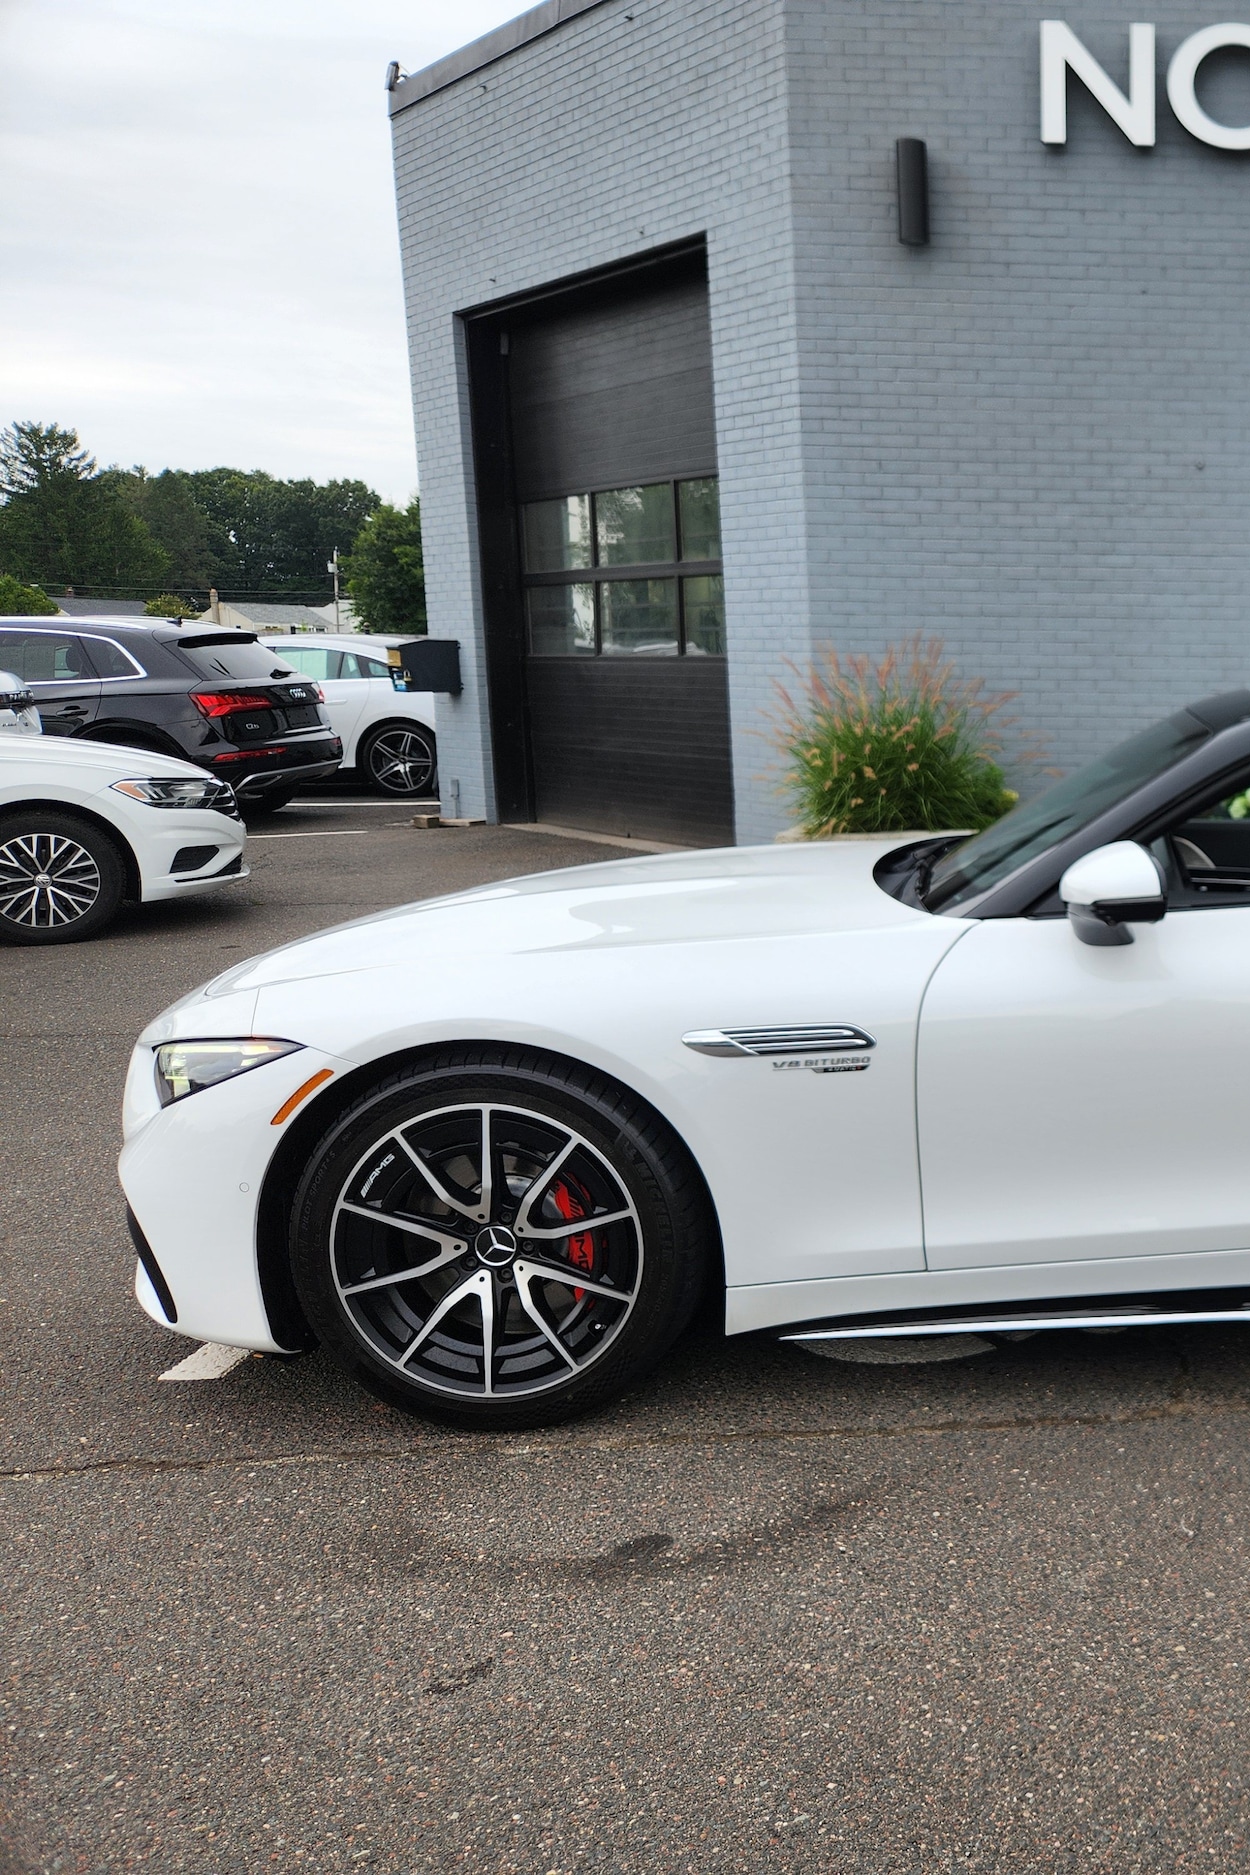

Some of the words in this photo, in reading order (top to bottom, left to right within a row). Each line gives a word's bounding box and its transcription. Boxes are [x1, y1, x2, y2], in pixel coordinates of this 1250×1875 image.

[772, 1060, 800, 1068] V8
[804, 1056, 871, 1066] BITURBO
[367, 1153, 396, 1186] AMG
